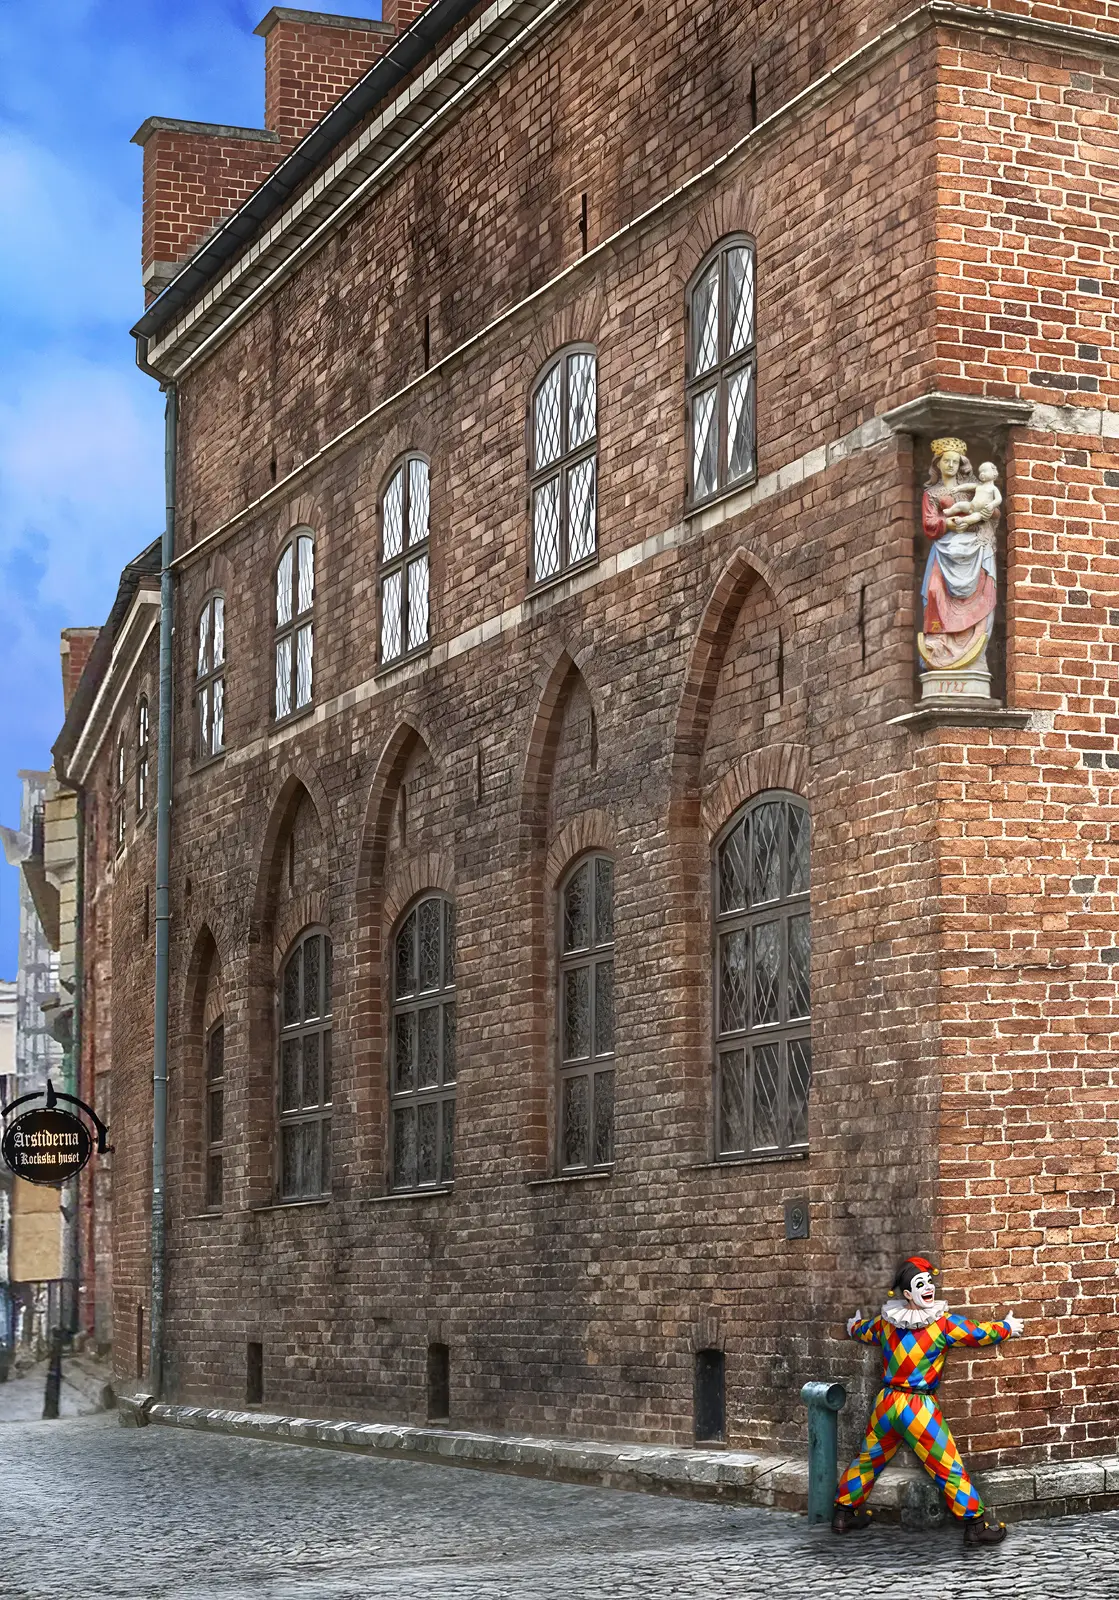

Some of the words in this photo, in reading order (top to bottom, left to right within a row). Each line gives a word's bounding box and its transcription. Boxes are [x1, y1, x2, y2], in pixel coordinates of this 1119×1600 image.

[13, 1125, 79, 1147] Årstiderna
[15, 1153, 18, 1165] i
[58, 1152, 80, 1165] huset
